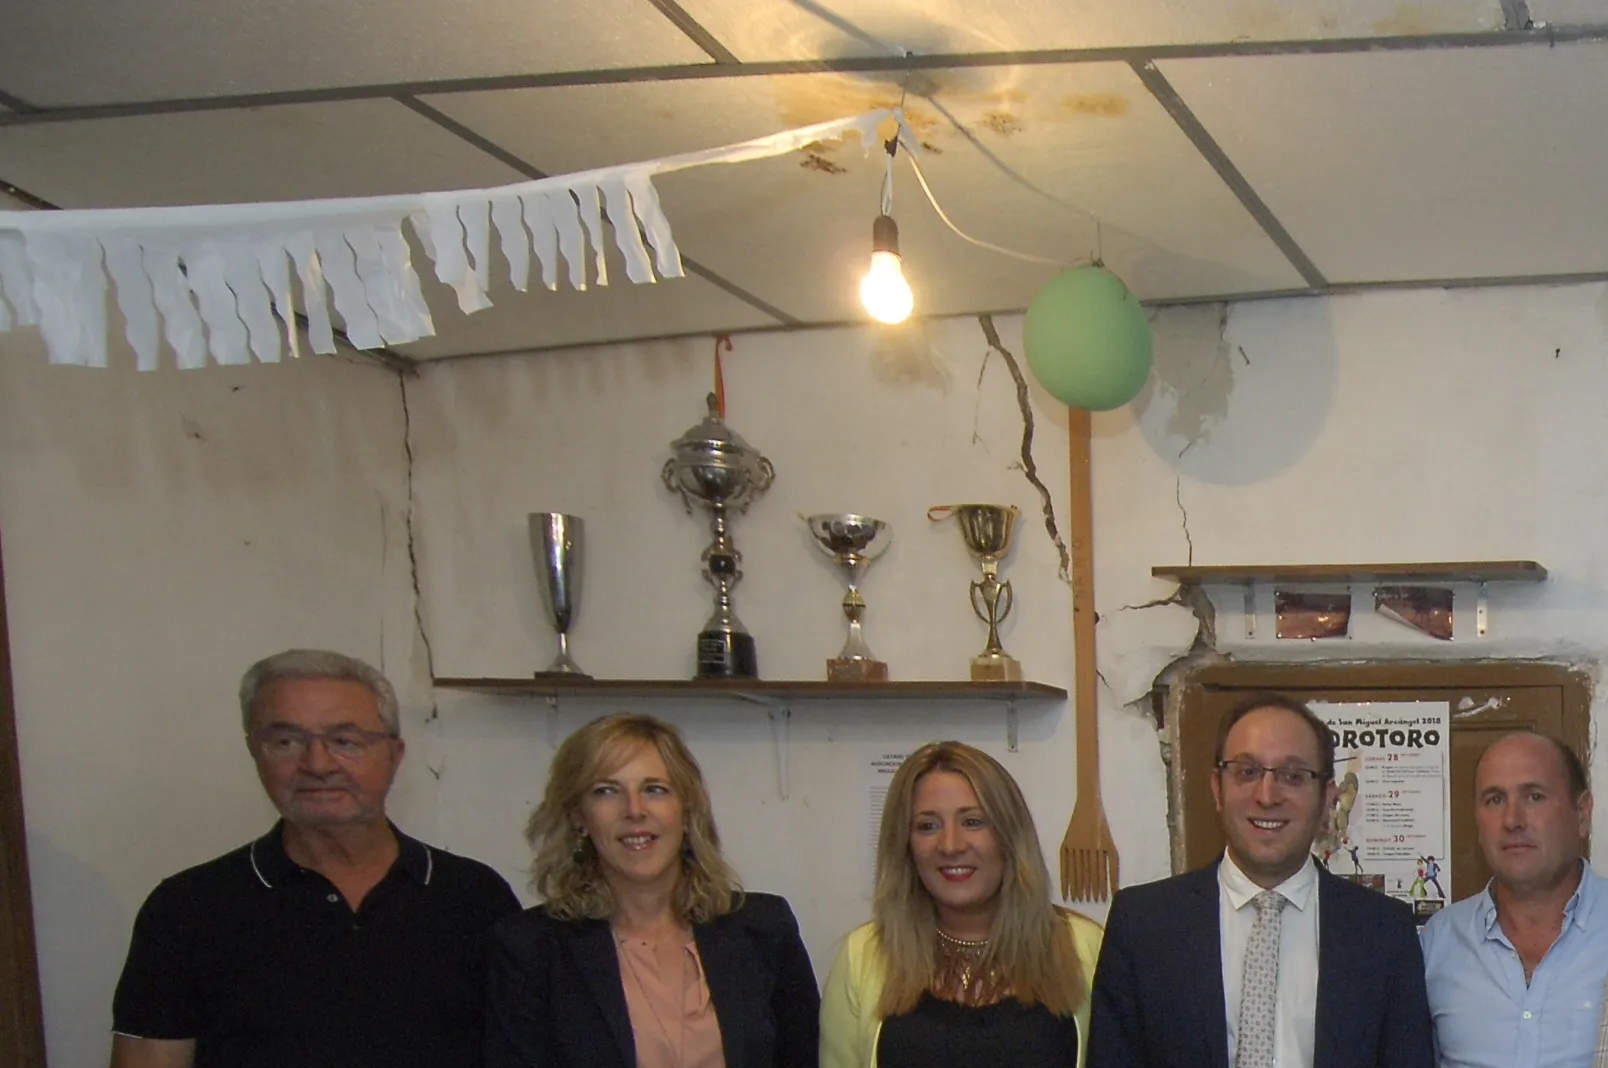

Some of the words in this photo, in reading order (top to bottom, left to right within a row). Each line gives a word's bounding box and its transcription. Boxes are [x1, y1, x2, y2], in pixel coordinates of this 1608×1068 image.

[1326, 718, 1336, 726] de
[1339, 718, 1353, 726] San
[1355, 718, 1382, 728] Miguel
[1384, 717, 1420, 727] Arcángel
[1421, 717, 1441, 725] 2018
[1387, 753, 1400, 761] 28
[1388, 790, 1400, 799] 29
[1393, 834, 1405, 843] 30
